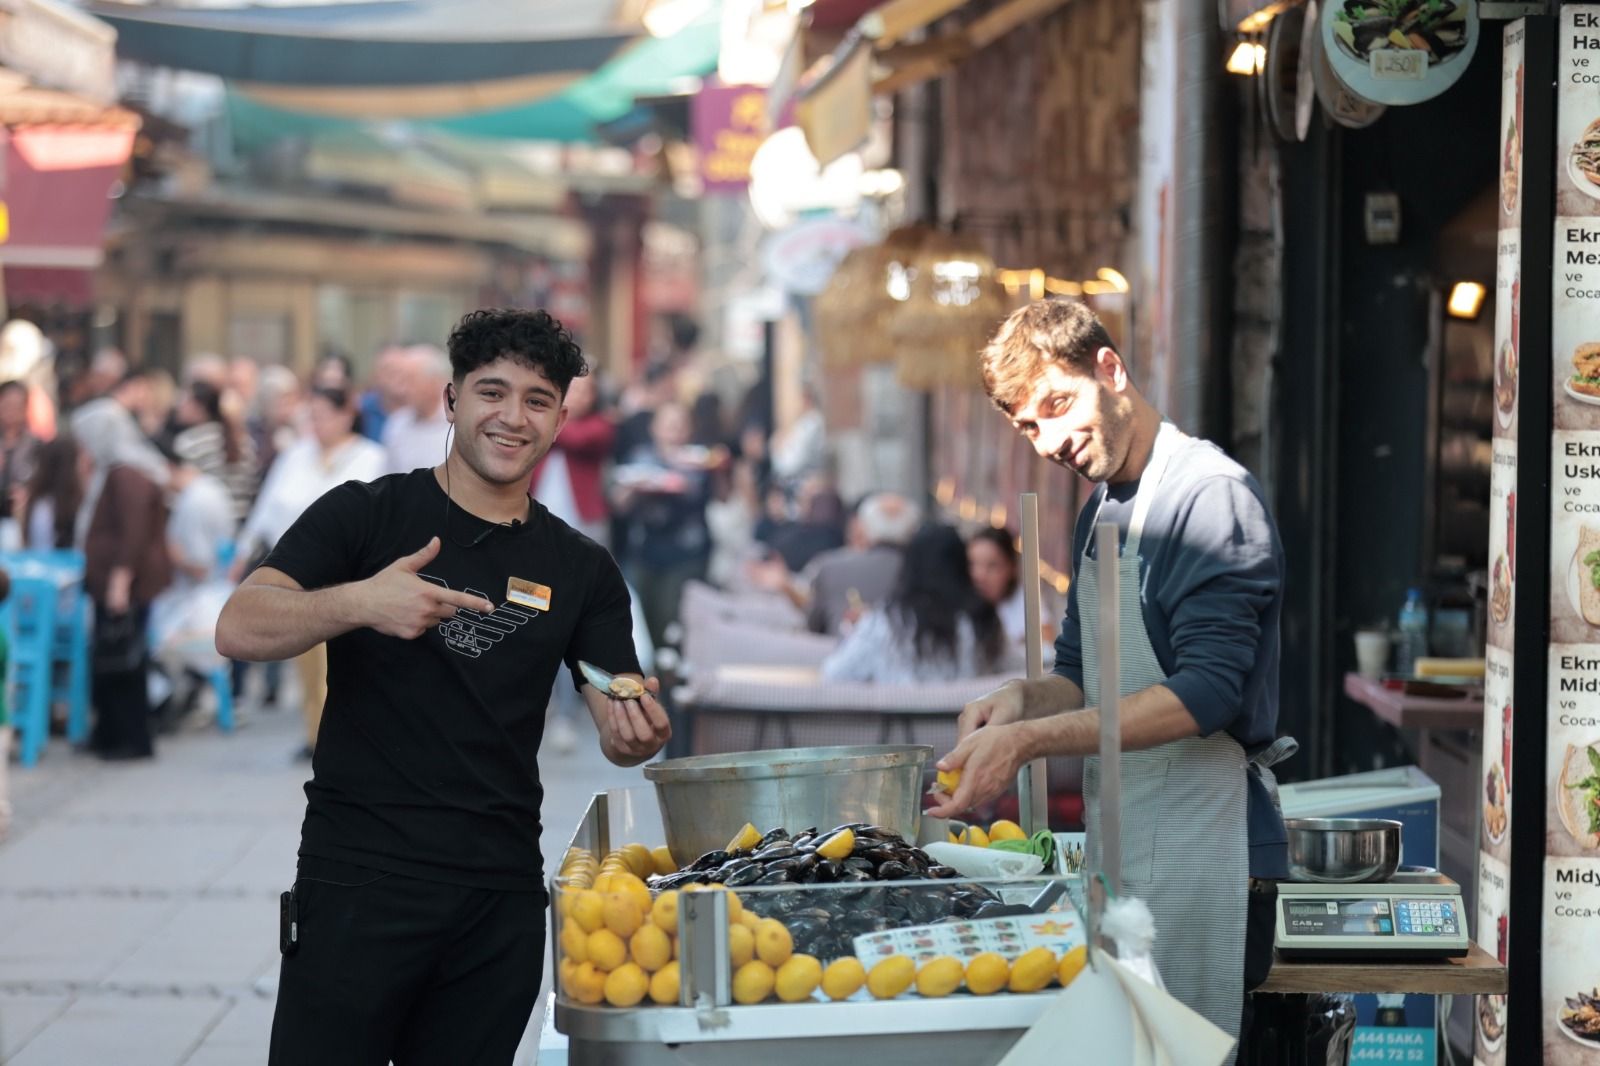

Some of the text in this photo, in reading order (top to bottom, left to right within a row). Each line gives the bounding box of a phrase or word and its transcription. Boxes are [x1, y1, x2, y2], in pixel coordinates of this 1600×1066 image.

[1572, 58, 1590, 67] ve
[1566, 250, 1600, 265] Me
[1565, 273, 1583, 282] ve
[1565, 464, 1600, 479] Usk
[1564, 487, 1582, 496] ve
[1564, 501, 1600, 513] Coca
[1561, 656, 1600, 671] Ekm
[1560, 677, 1600, 696] Mid
[1560, 700, 1577, 710] ve
[1555, 891, 1572, 900] ve
[1554, 905, 1600, 917] Coca-
[1387, 1032, 1424, 1044] SAKA
